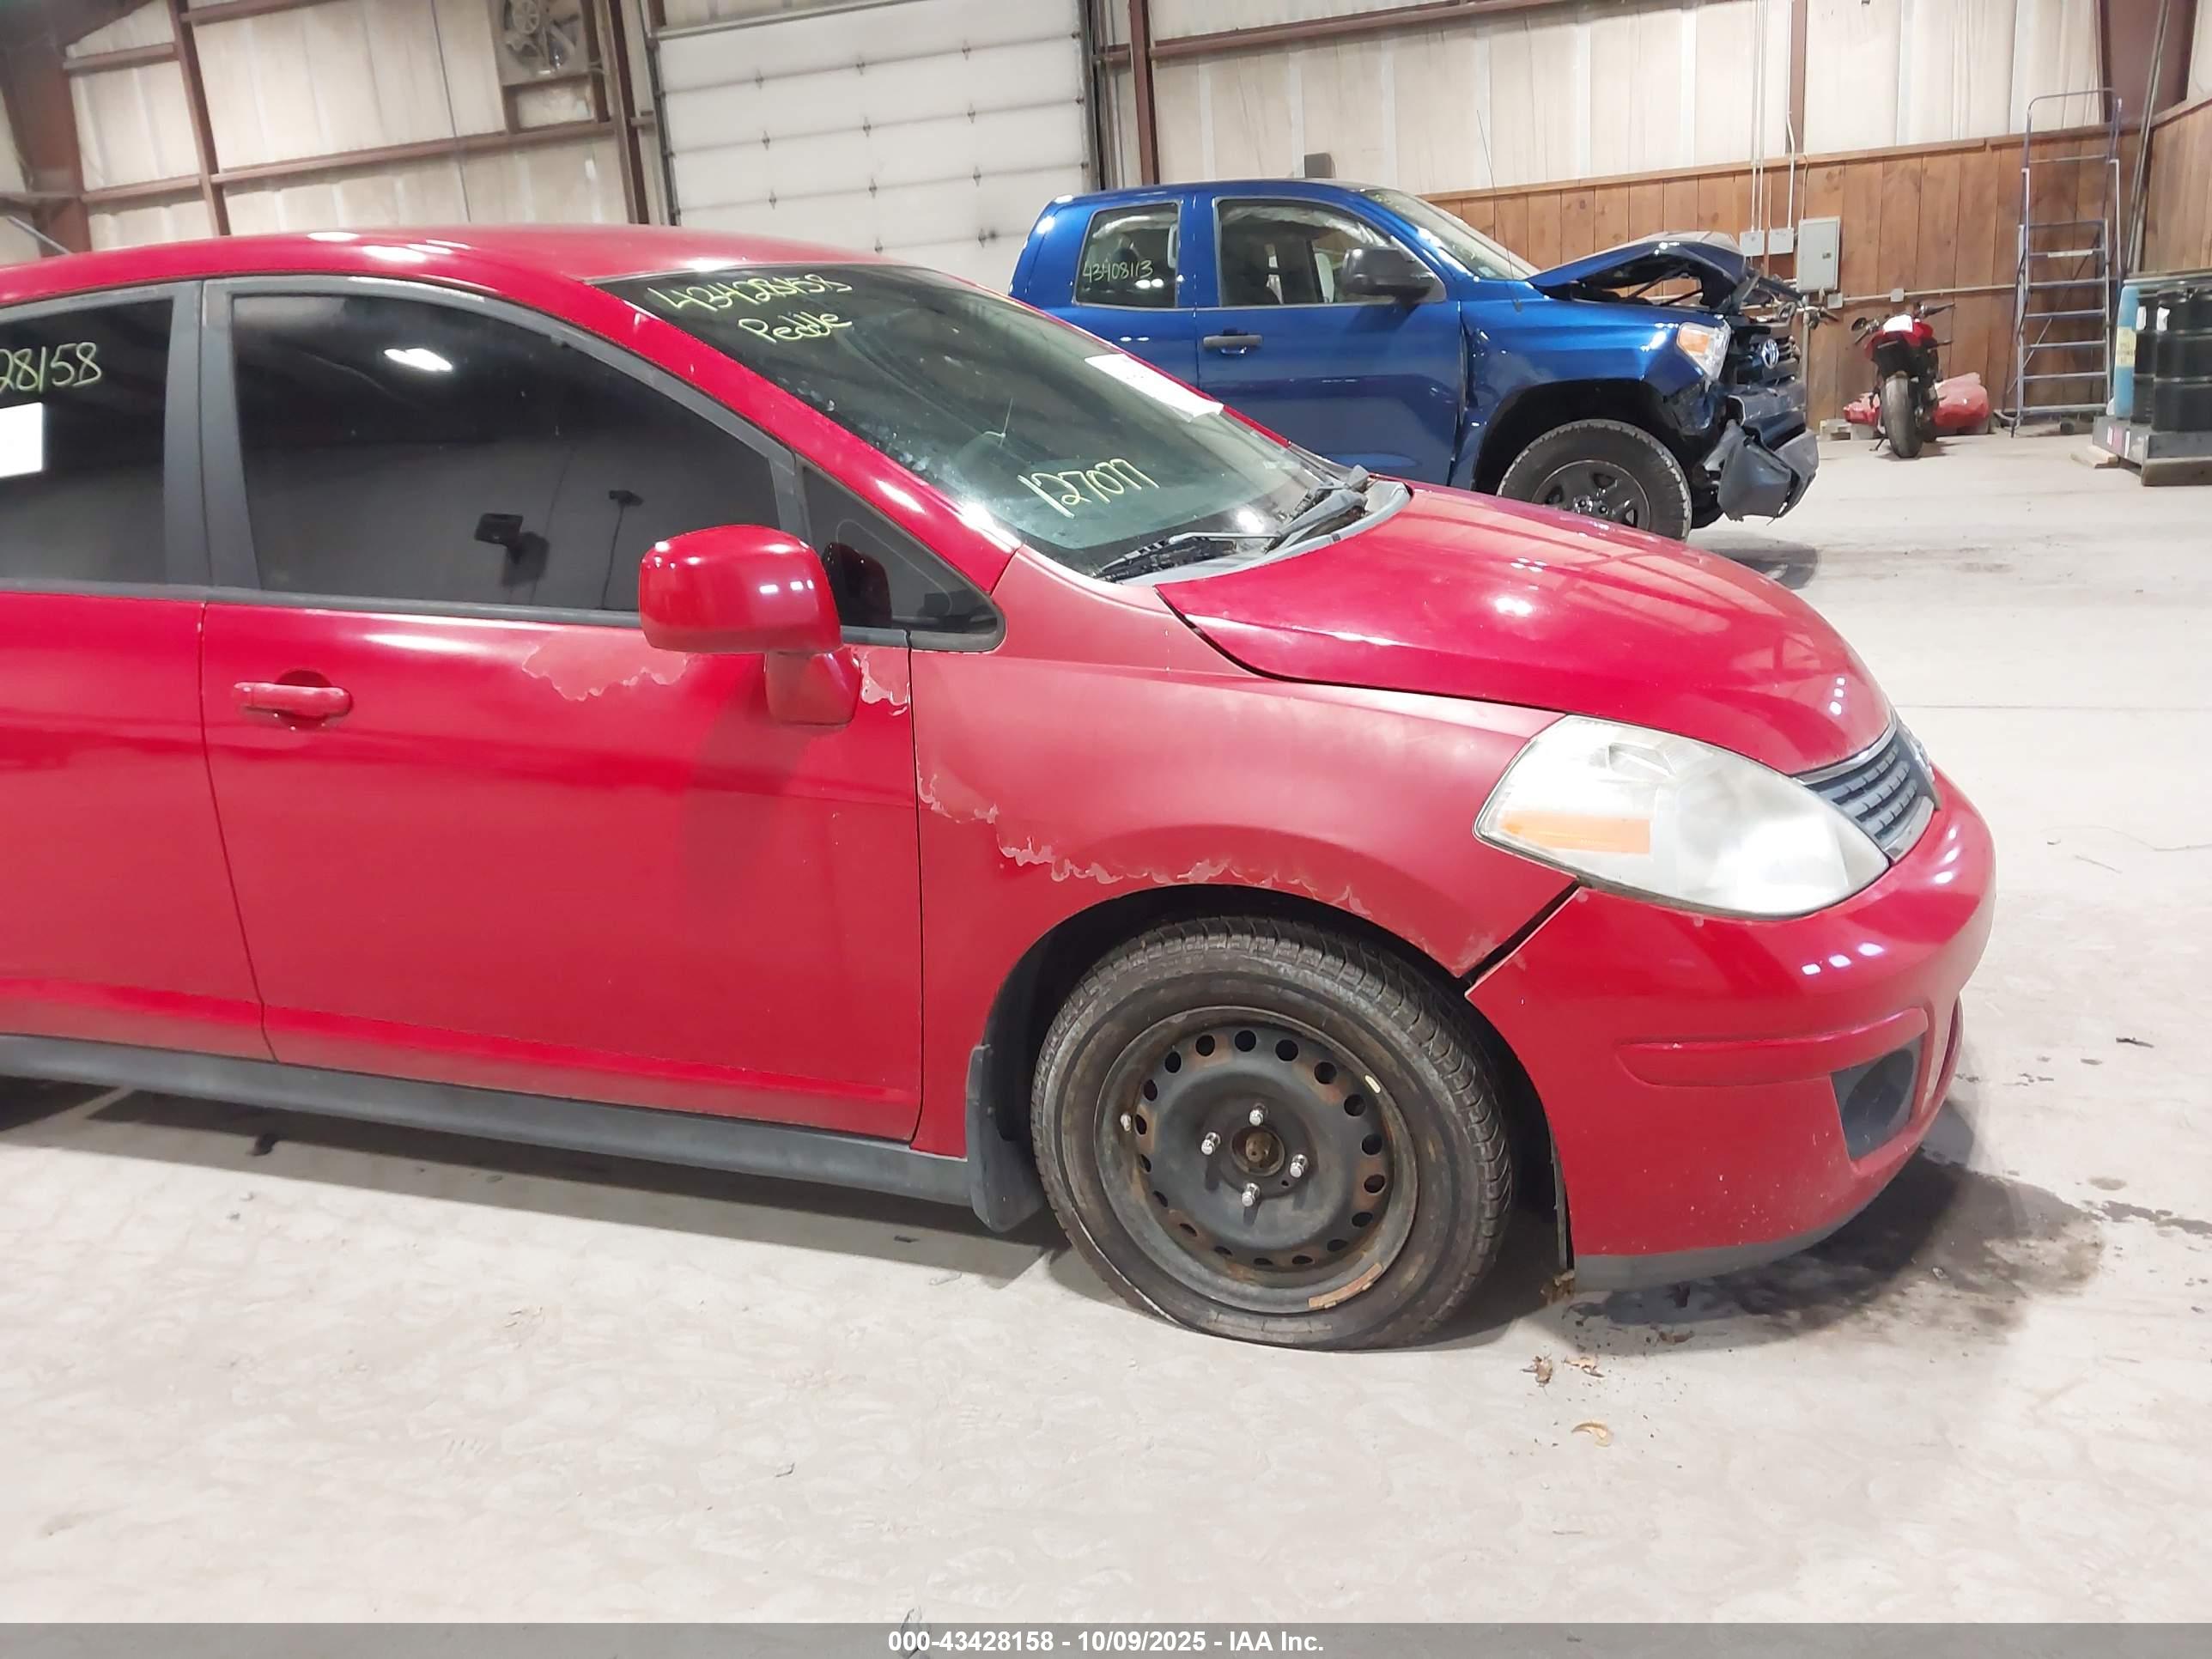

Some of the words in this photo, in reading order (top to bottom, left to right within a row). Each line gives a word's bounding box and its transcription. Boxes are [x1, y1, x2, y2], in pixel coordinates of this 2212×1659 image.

[1082, 259, 1153, 283] 43408113
[647, 272, 854, 313] 43428158
[1017, 457, 1161, 520] 127077
